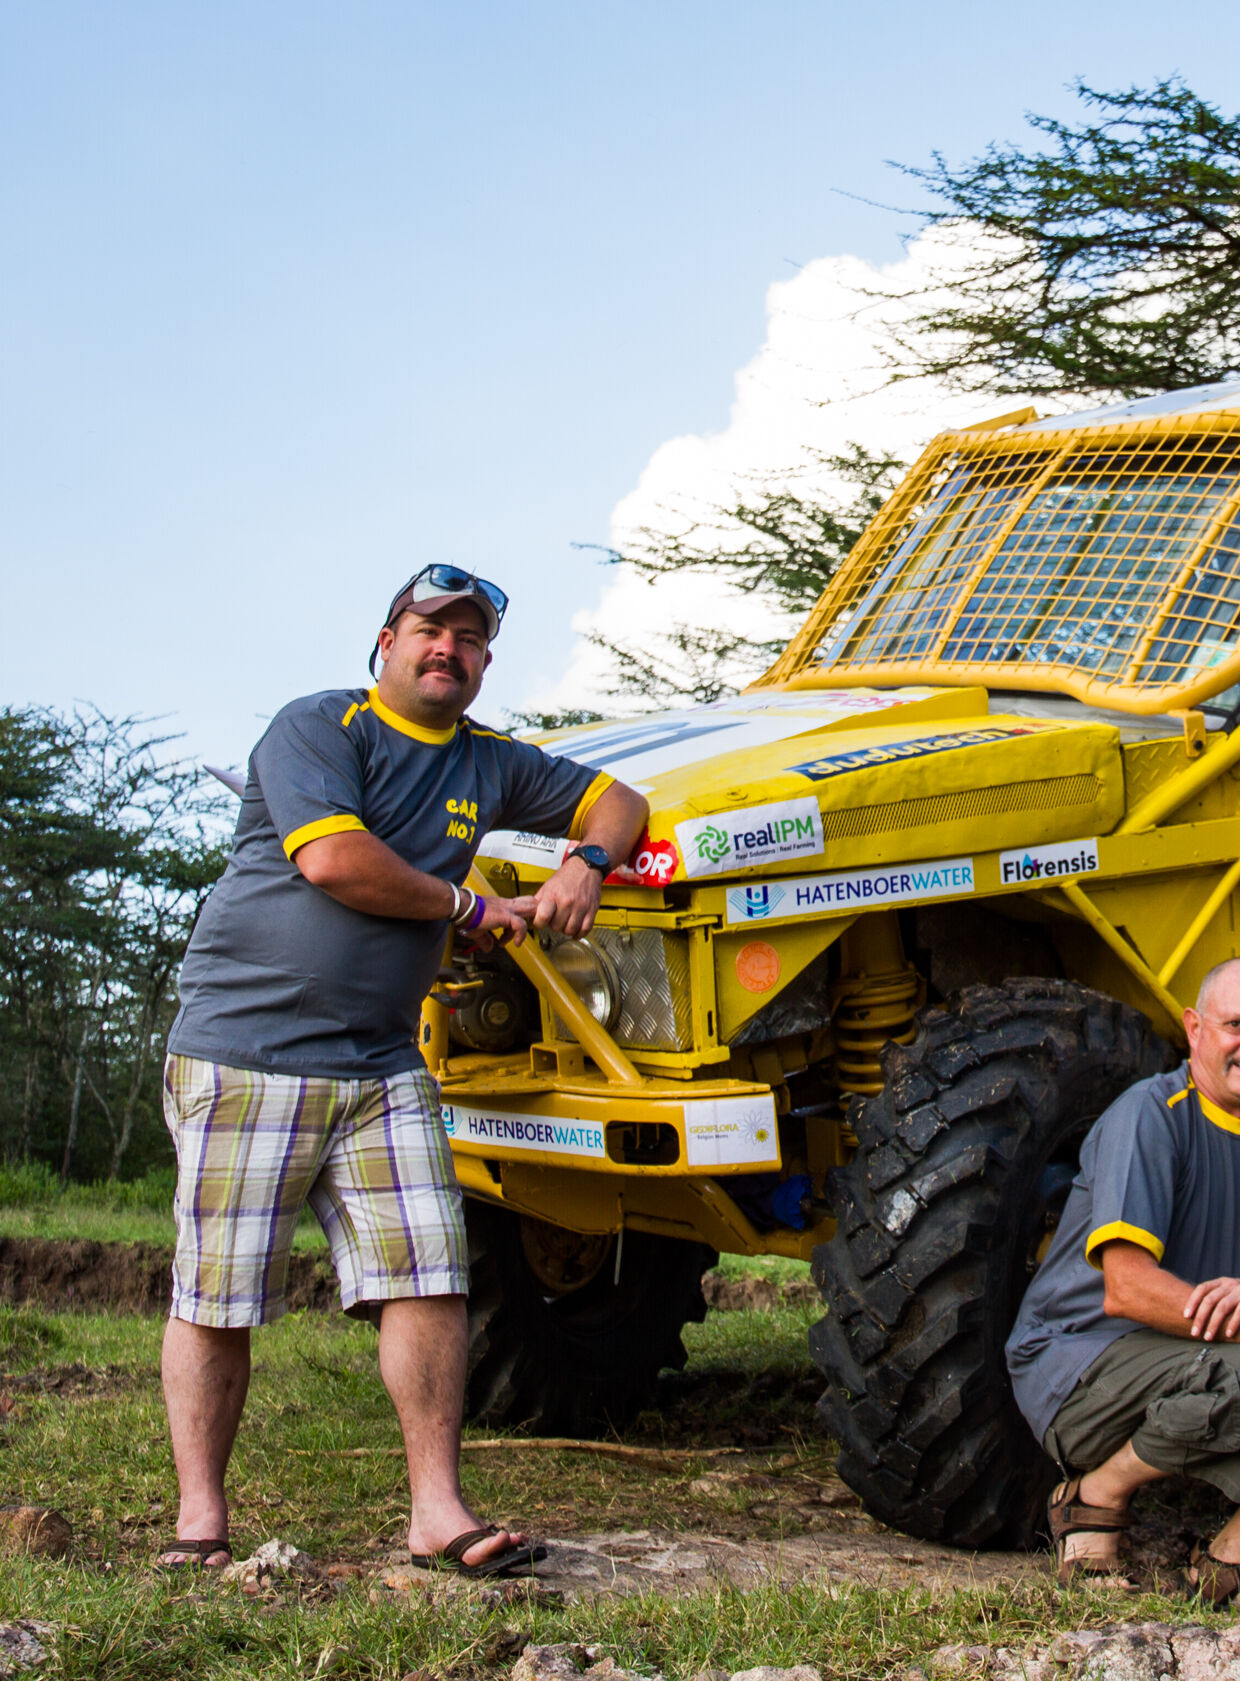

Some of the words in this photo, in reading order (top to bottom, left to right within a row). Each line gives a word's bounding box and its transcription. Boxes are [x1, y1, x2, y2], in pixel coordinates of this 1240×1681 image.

[807, 730, 1008, 776] dudutech
[446, 799, 478, 823] CAR
[733, 815, 815, 851] realIPM
[749, 848, 775, 858] Solutions
[793, 841, 815, 850] Farming
[1003, 851, 1097, 883] Florensis
[796, 866, 973, 906] HATENBOERWATER
[468, 1116, 604, 1150] HATENBOERWATER
[690, 1123, 739, 1134] GEDIFLORA
